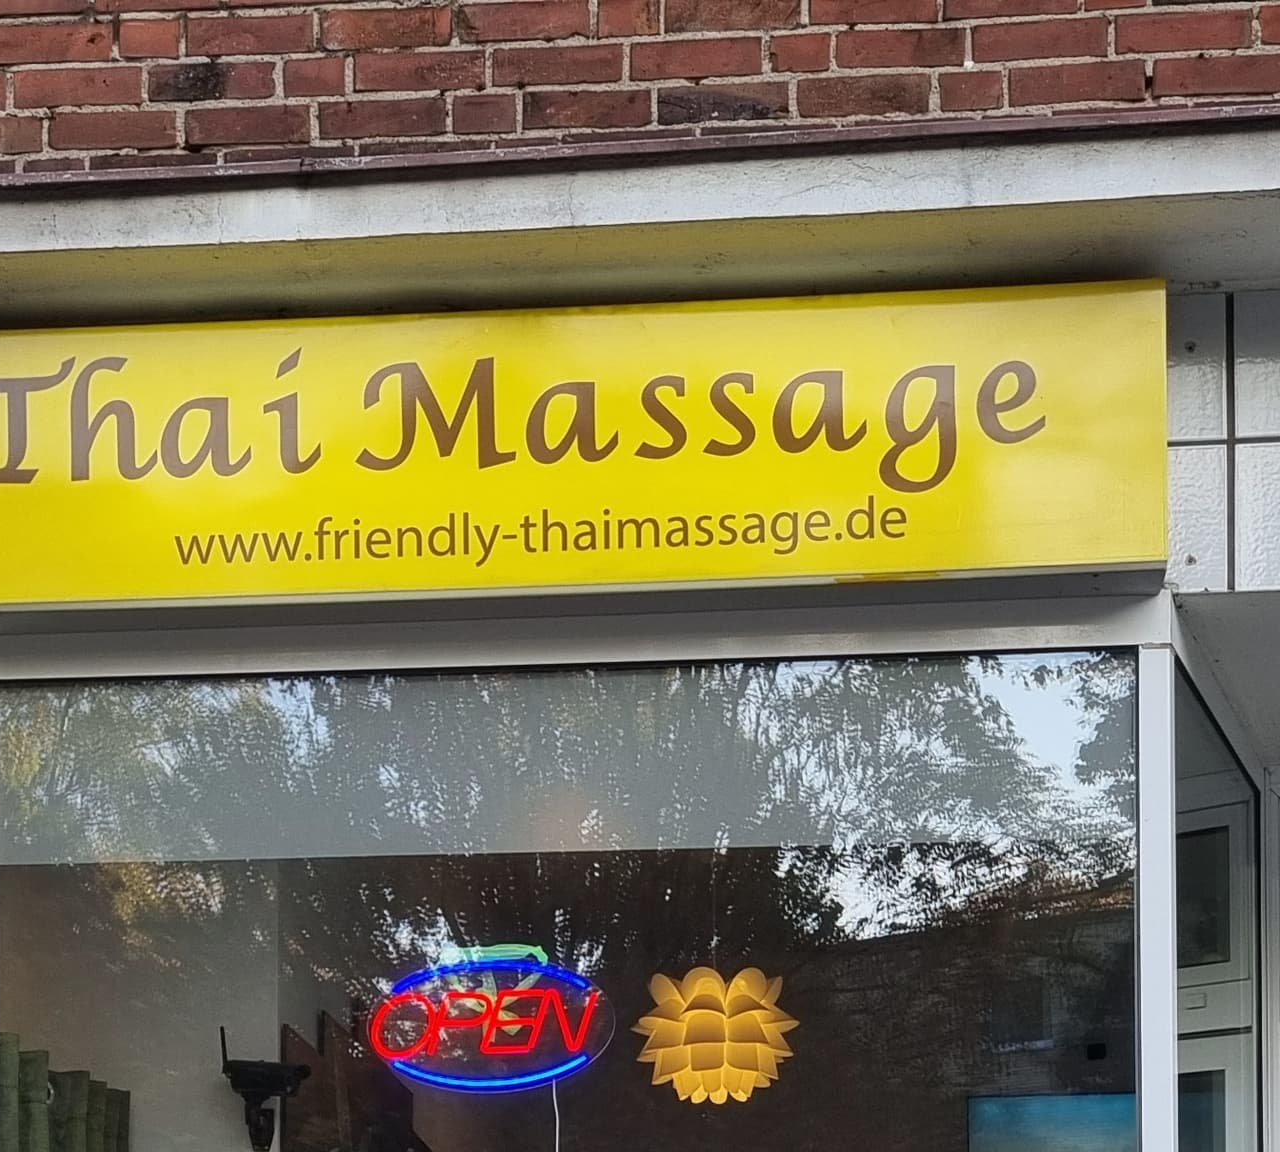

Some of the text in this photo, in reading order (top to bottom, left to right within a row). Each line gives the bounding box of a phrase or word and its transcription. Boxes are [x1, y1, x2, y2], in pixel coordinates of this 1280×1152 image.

[356, 357, 1045, 493] Massage
[175, 495, 906, 567] www.friendly-thaimassage.de
[370, 988, 599, 1058] OPEN
